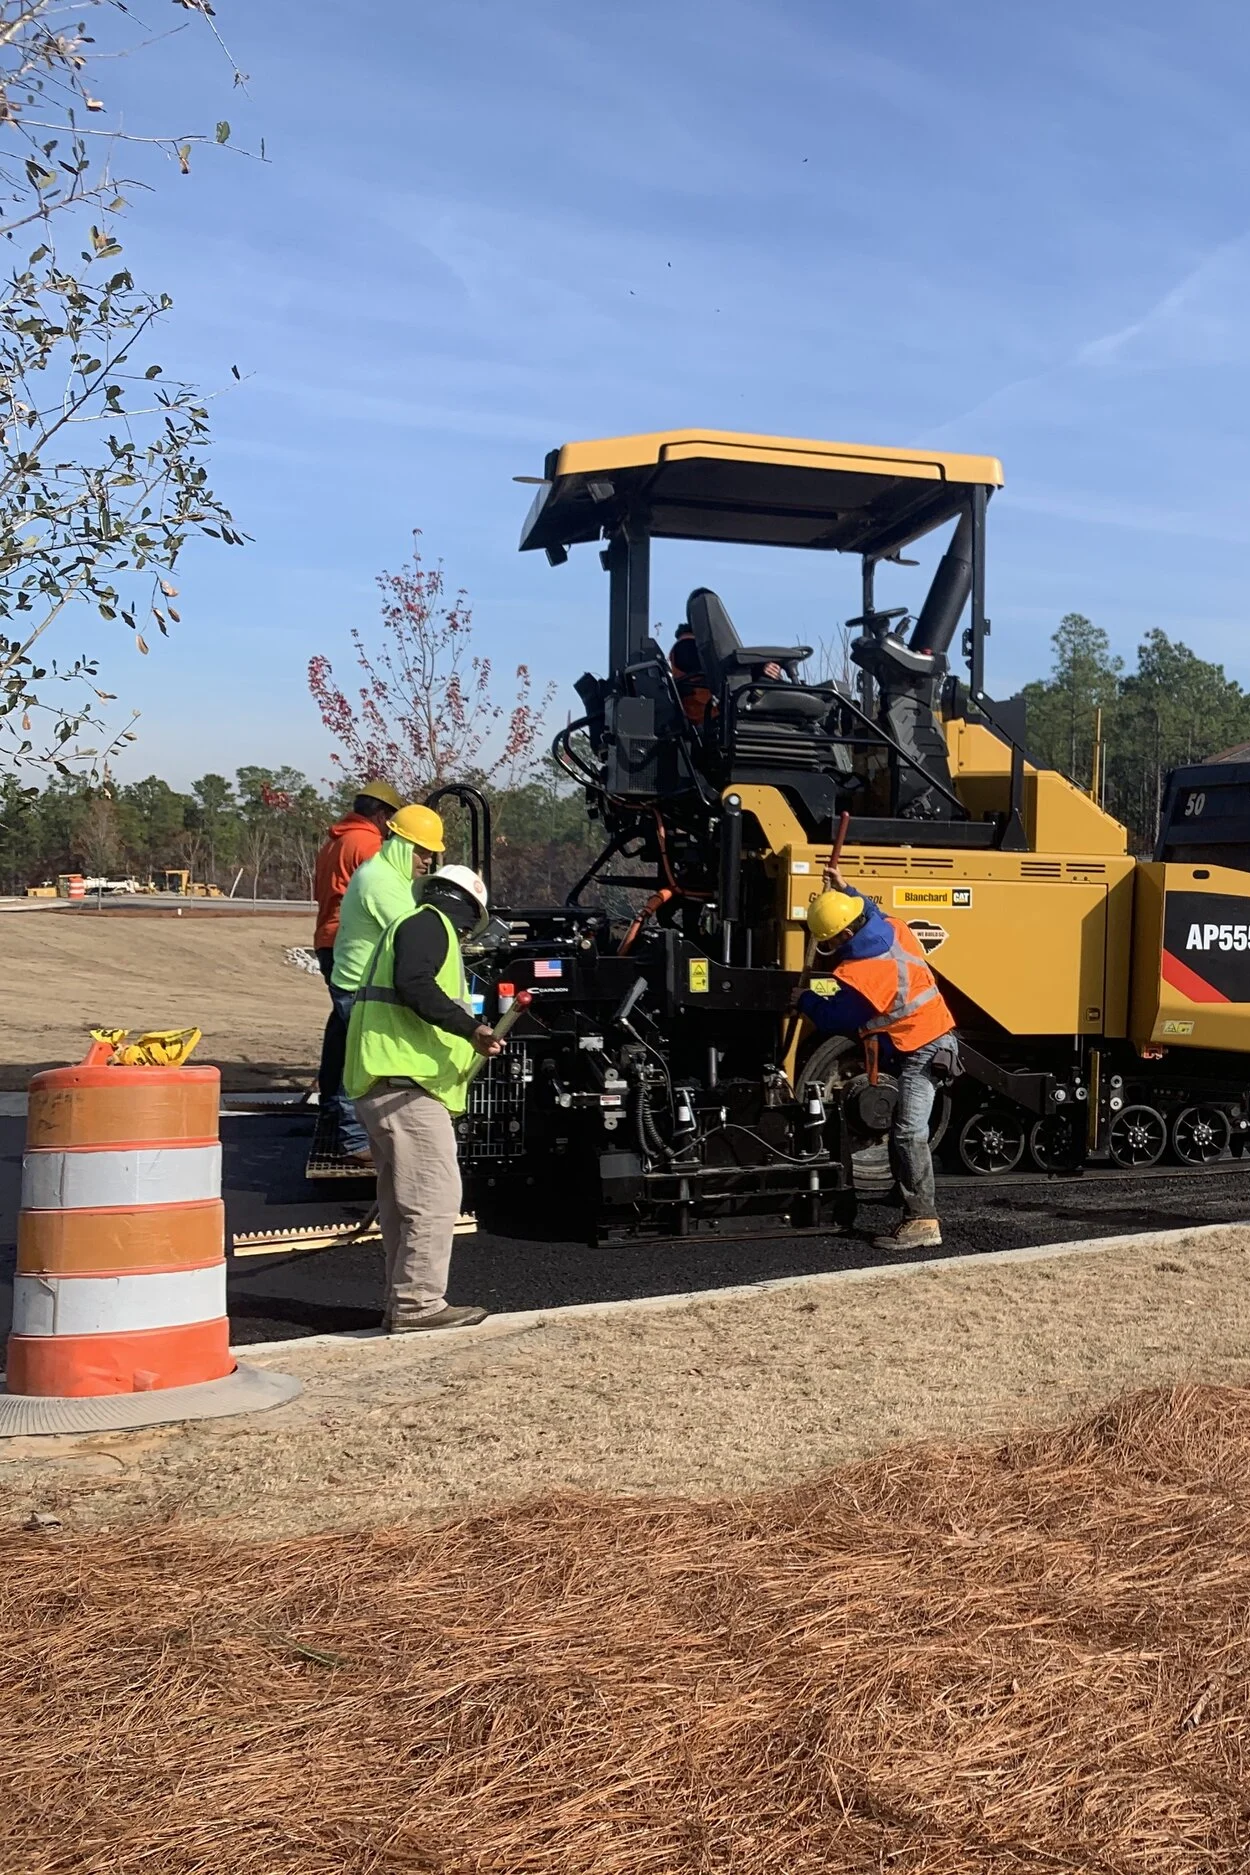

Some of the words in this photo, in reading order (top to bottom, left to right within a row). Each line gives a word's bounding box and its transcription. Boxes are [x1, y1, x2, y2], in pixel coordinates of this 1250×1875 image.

[1185, 793, 1206, 817] 50
[904, 892, 948, 903] Blanchard
[953, 892, 970, 903] CAT
